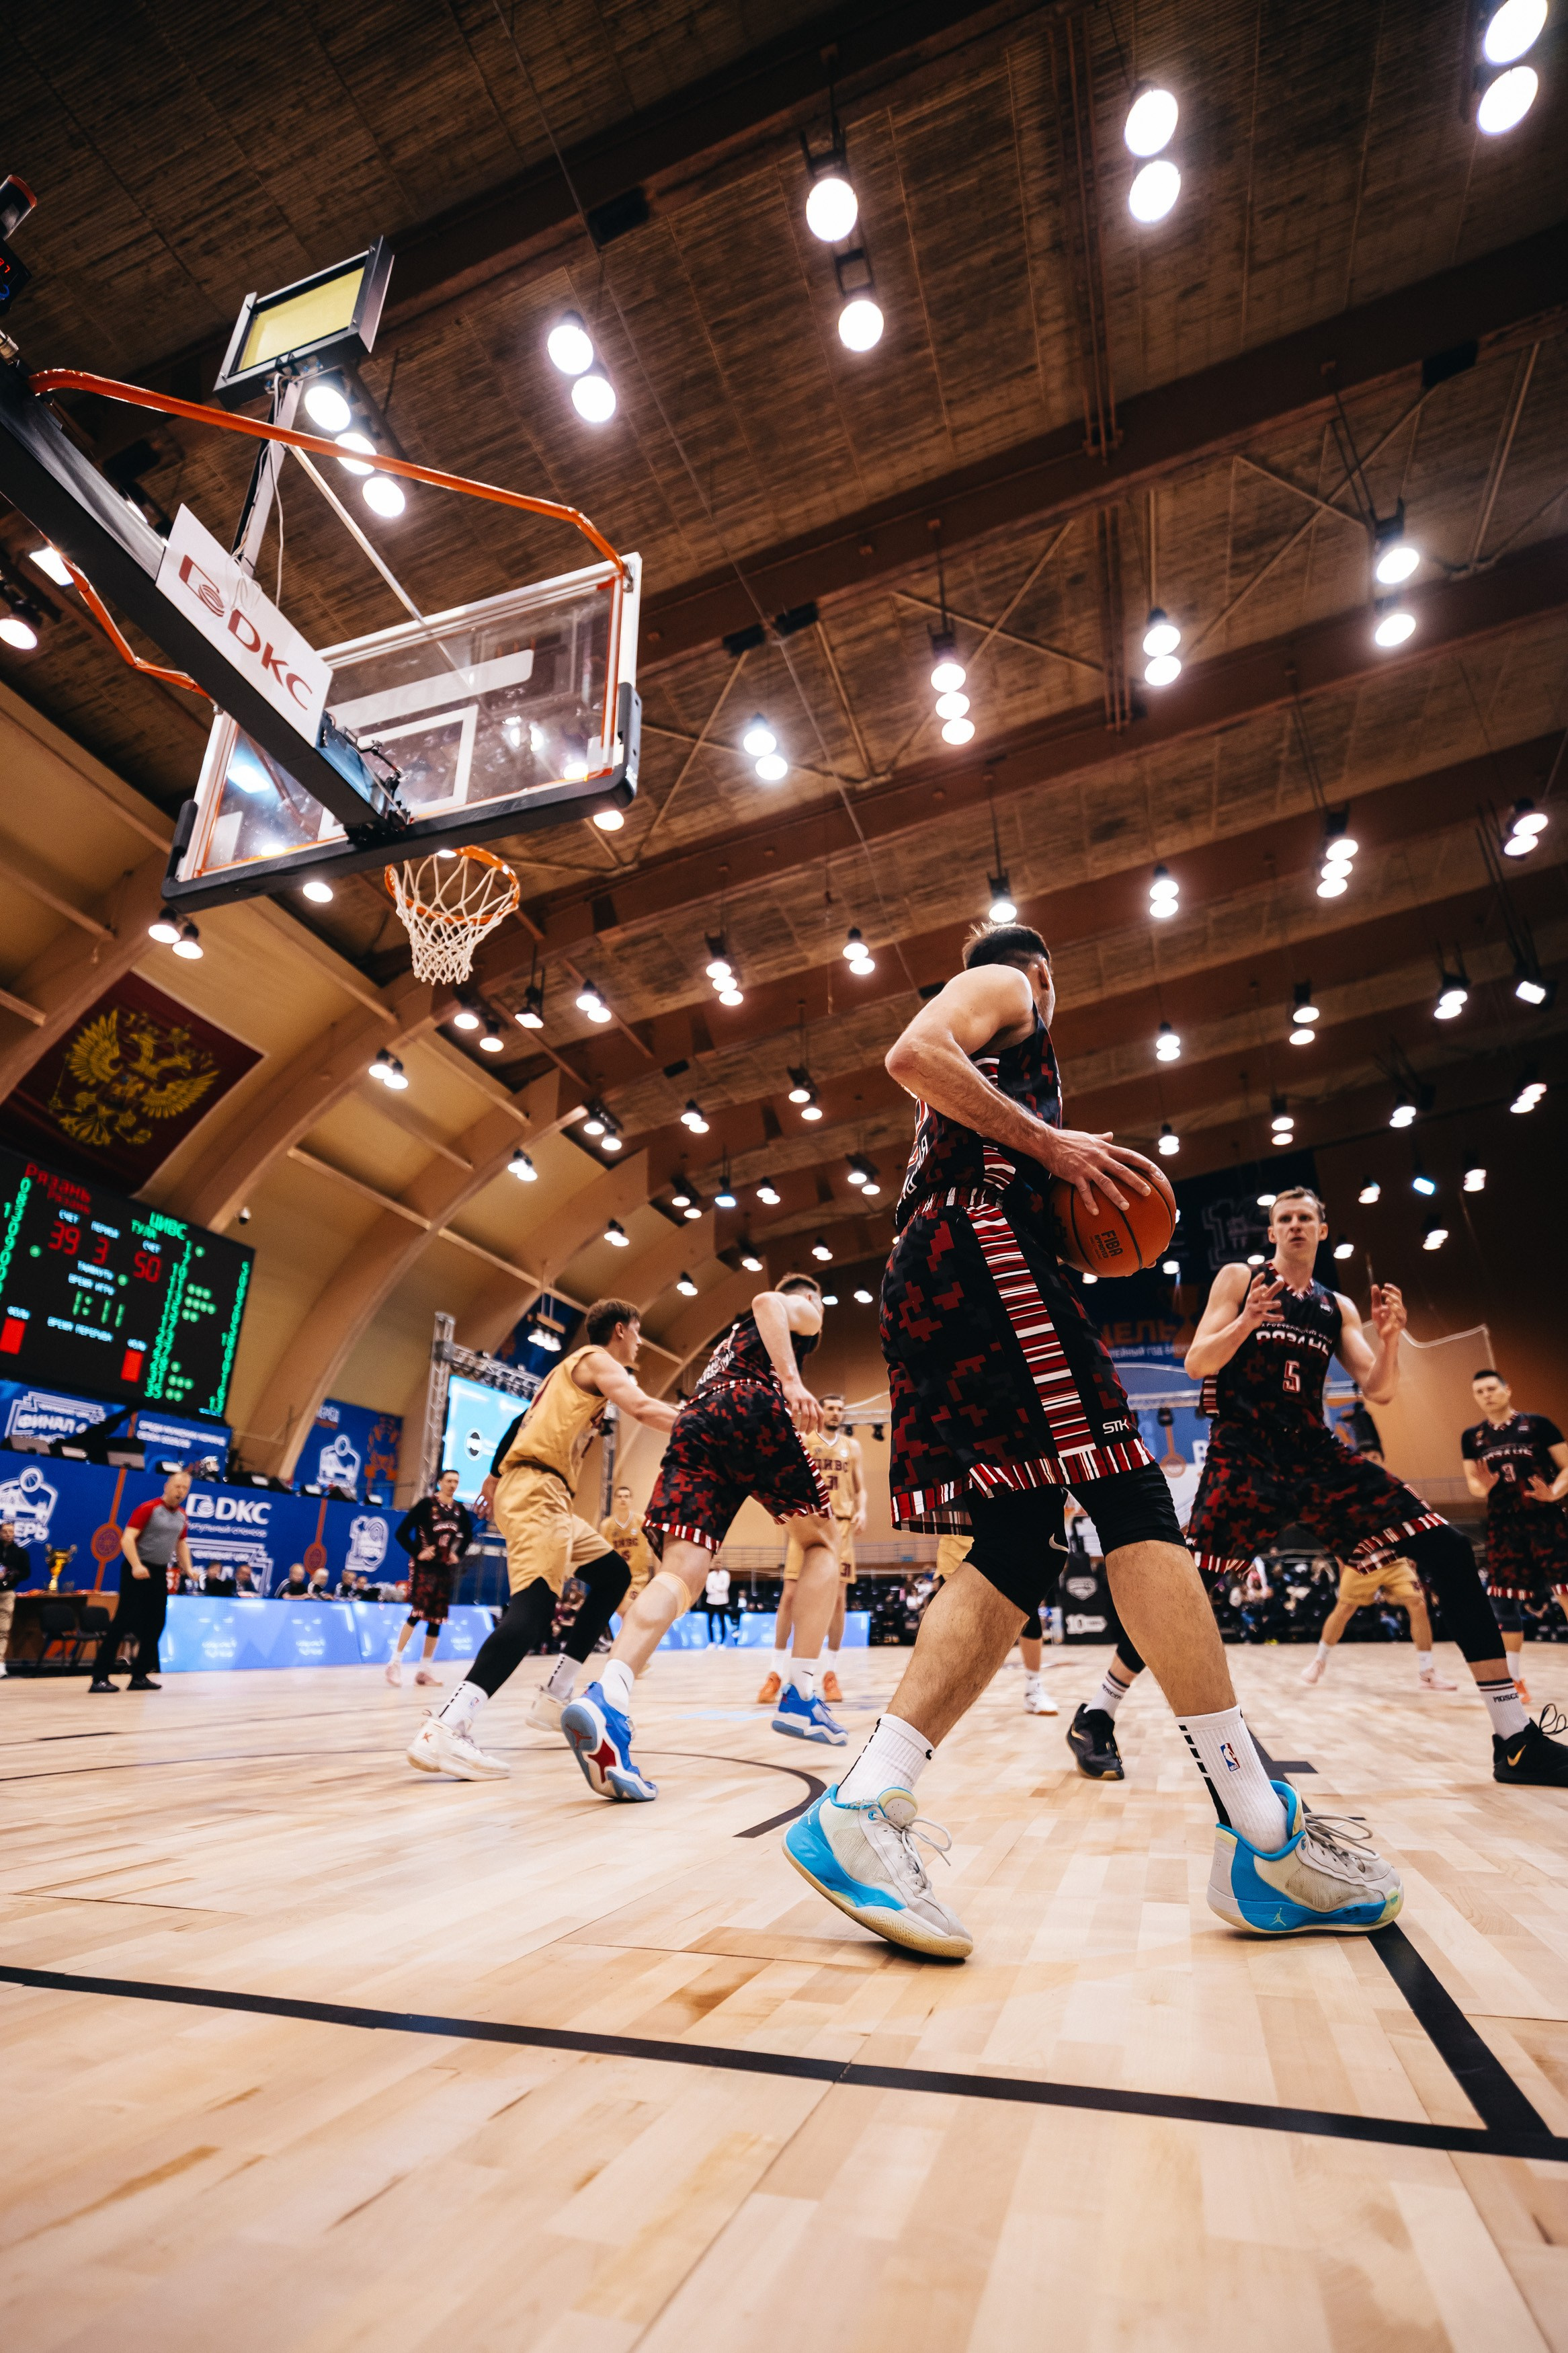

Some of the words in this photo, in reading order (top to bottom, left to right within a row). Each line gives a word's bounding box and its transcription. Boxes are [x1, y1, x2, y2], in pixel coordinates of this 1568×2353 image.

[227, 608, 313, 711] DKC
[48, 1220, 81, 1255] 39
[92, 1236, 110, 1265] 3
[1094, 1234, 1109, 1259] APPROVED
[1101, 1230, 1124, 1257] FIBA
[133, 1250, 162, 1283] 50
[1282, 1359, 1301, 1394] 5
[1102, 1419, 1130, 1434] STK
[214, 1497, 272, 1525] DKC
